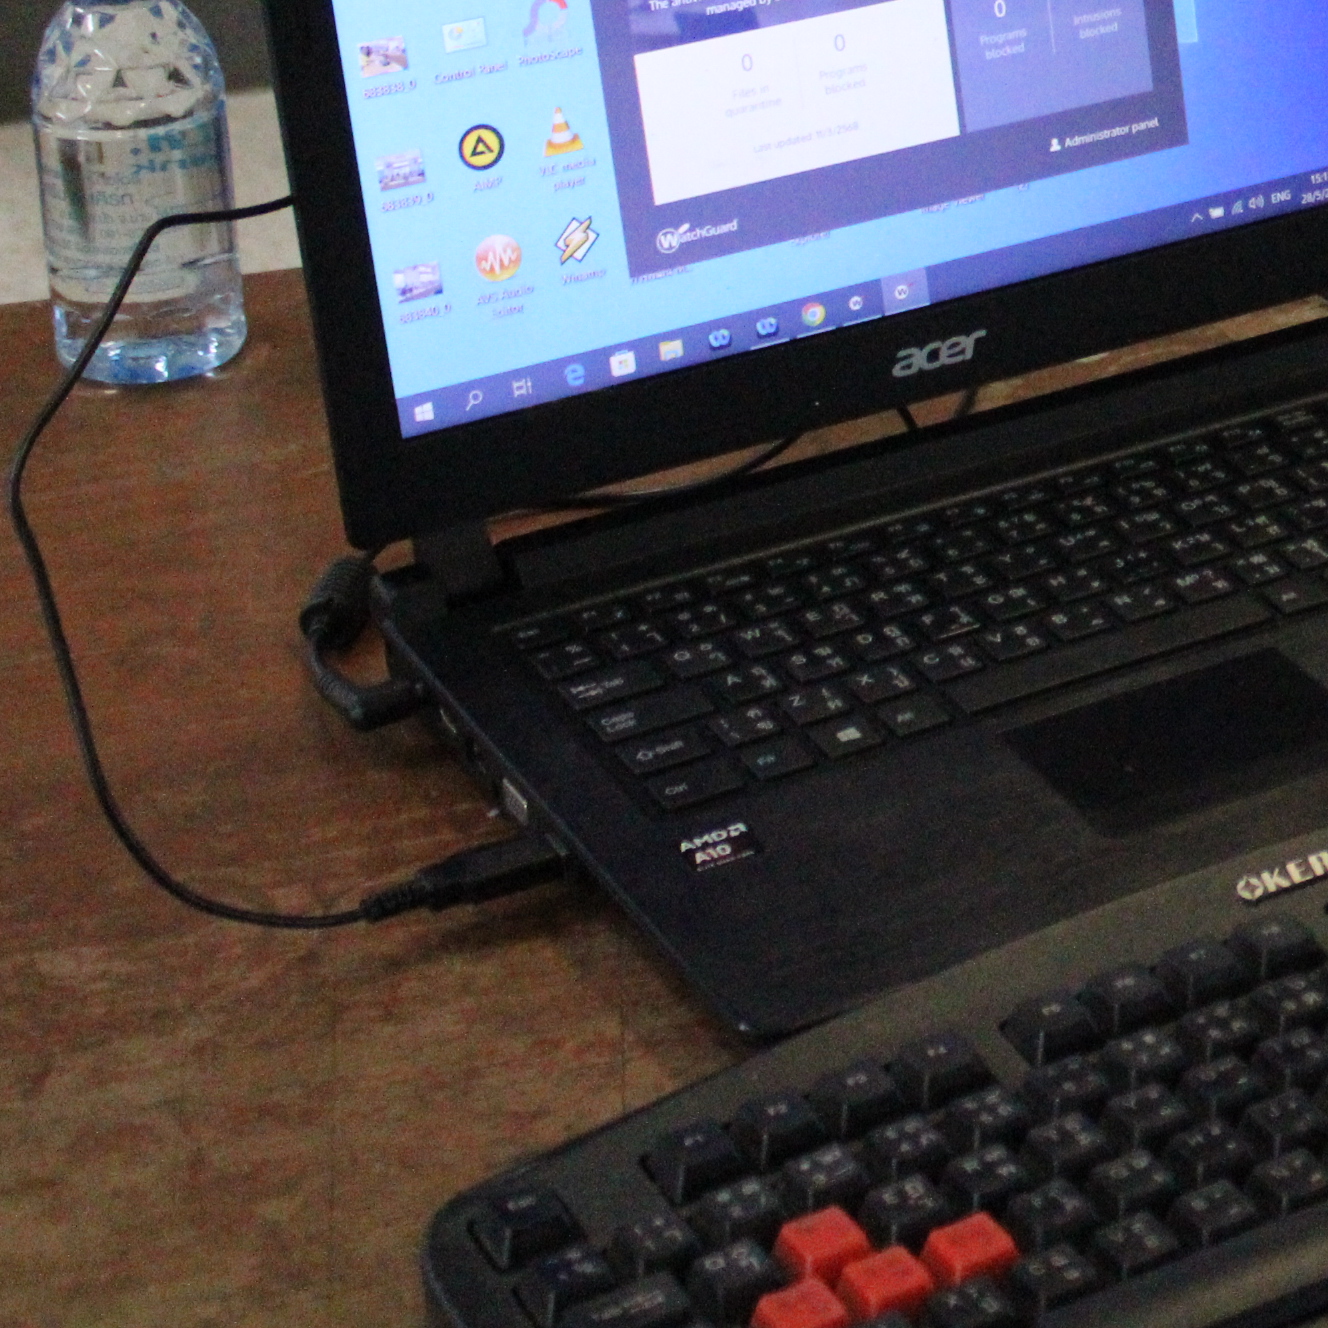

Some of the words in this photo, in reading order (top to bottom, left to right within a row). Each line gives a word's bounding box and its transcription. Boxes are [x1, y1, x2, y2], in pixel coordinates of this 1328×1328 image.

[833, 33, 846, 53] 0
[741, 53, 754, 73] 0
[1064, 123, 1130, 149] Administrator
[1132, 117, 1159, 135] panel
[1271, 190, 1291, 205] ENG
[655, 218, 739, 254] WatchGuard
[891, 329, 986, 378] acer
[694, 843, 732, 864] A10
